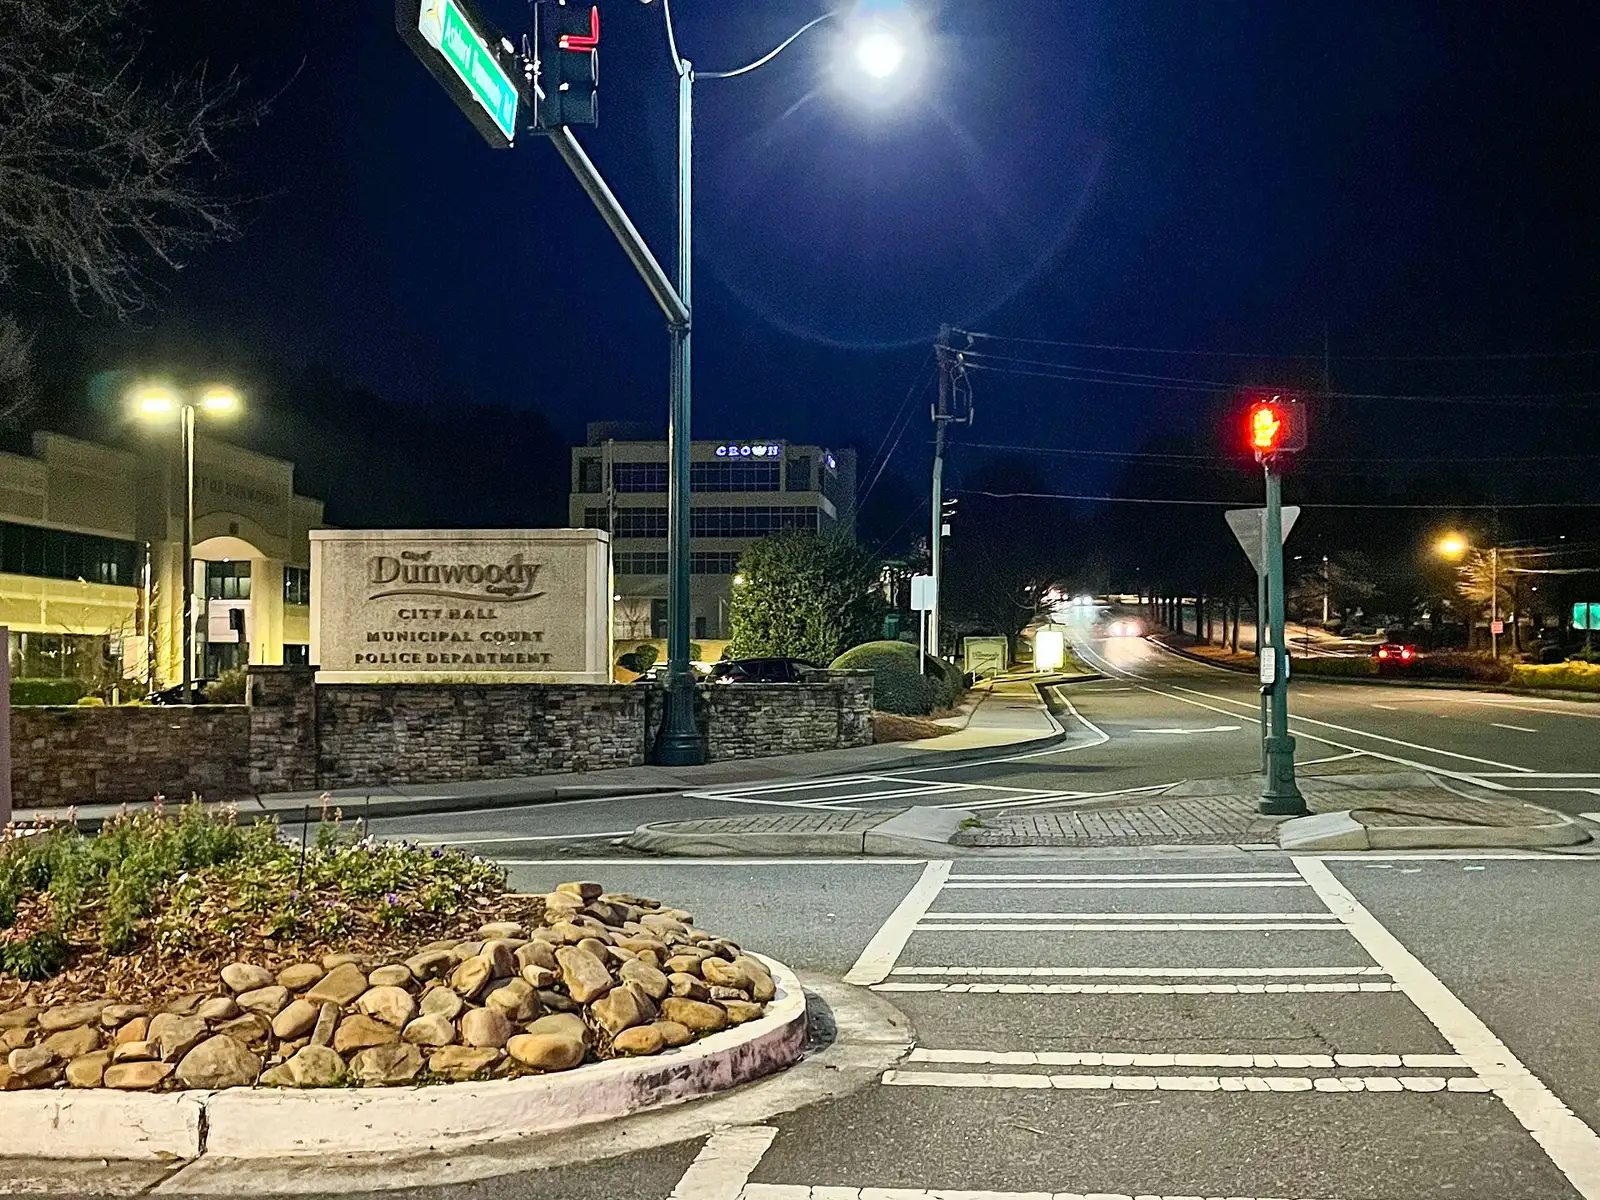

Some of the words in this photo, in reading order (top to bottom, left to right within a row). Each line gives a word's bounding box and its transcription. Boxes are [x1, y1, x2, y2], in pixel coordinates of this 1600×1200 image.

[715, 445, 779, 457] CROWN
[371, 553, 541, 592] Dunwoody
[398, 608, 441, 619] CITY
[447, 608, 498, 619] HALL
[366, 631, 473, 642] MUNICIPAL
[480, 631, 545, 642] COURT
[355, 653, 422, 664] POLICE
[426, 653, 552, 664] DEPARTMENT
